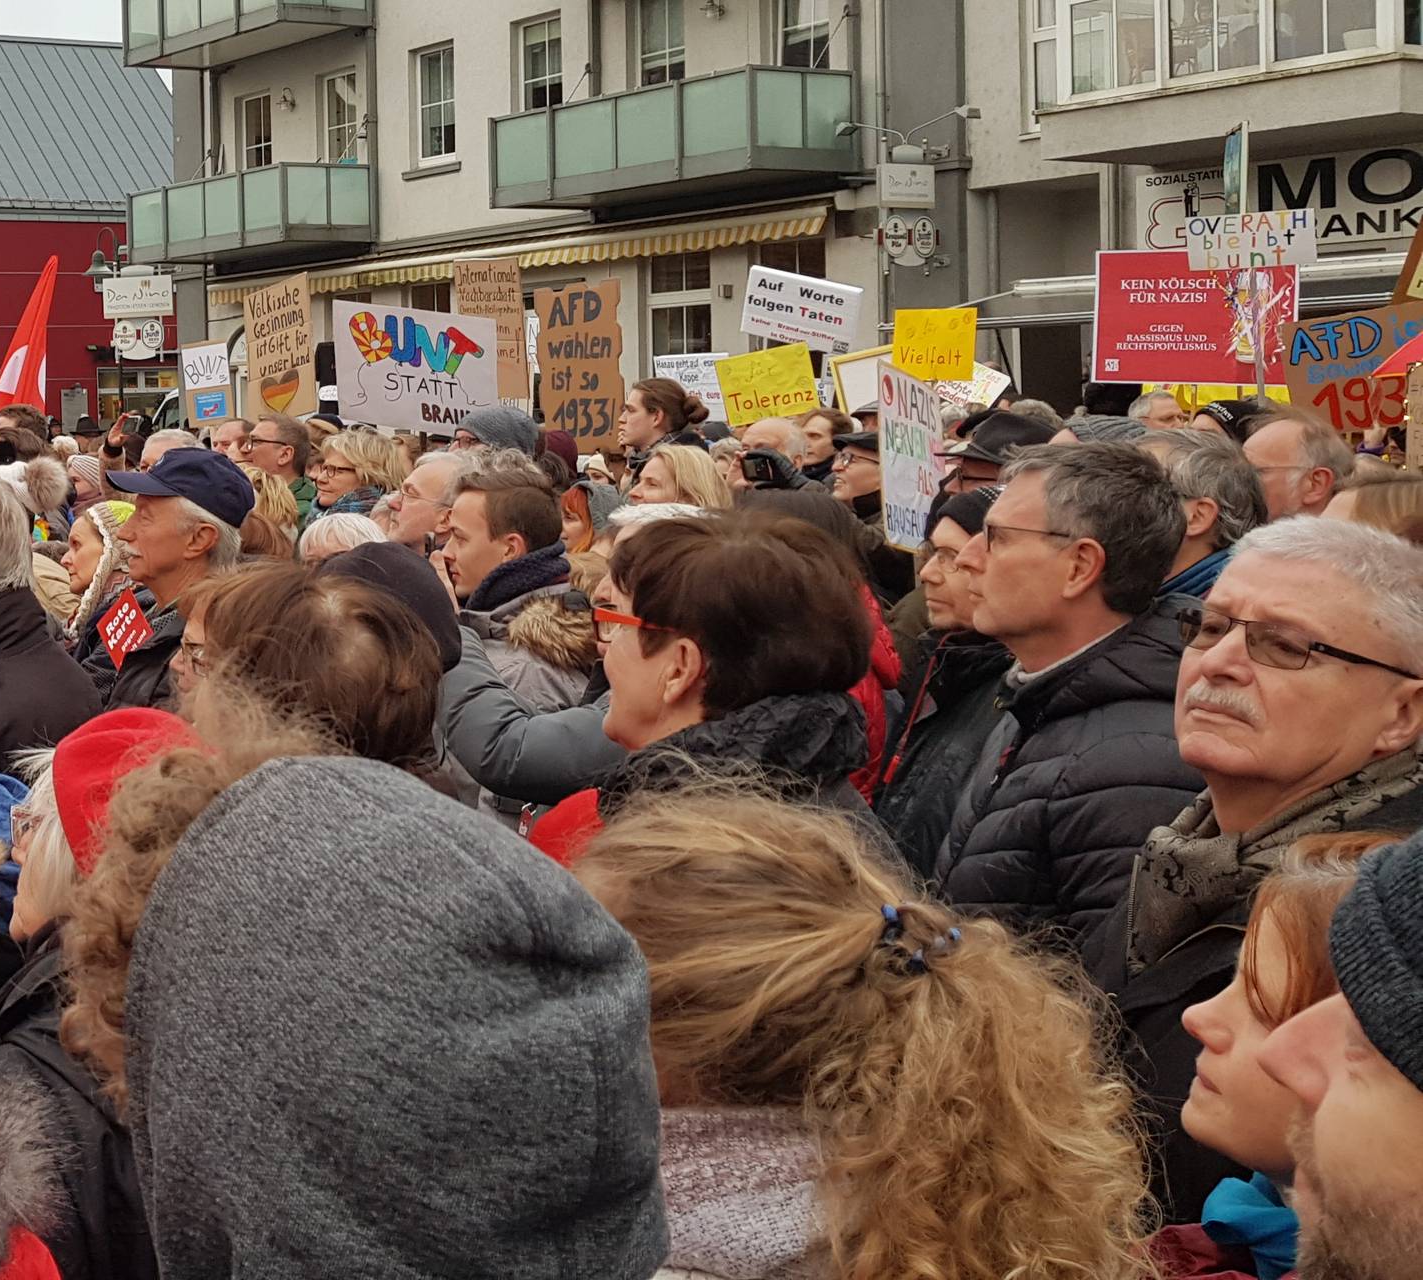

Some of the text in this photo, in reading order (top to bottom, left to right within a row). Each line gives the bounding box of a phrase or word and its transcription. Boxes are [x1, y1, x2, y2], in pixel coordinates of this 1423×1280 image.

[1145, 169, 1224, 187] SOZIALSTATI
[1188, 210, 1307, 236] OVERATH
[1315, 206, 1423, 238] ANK
[1203, 229, 1295, 249] bleibt
[1206, 245, 1286, 269] bunt
[456, 265, 517, 286] Internationale
[1121, 276, 1217, 290] KEIN KÖLSCH
[248, 285, 300, 320] Völkische
[757, 278, 845, 306] Auf Worte
[1129, 291, 1207, 303] FÜR NAZIS!
[253, 308, 305, 339] Gesinnung
[547, 291, 602, 329] AFD
[747, 294, 843, 326] folgen Taten
[295, 329, 308, 351] für
[1126, 334, 1207, 342] RASSISMUS UND
[1149, 324, 1184, 332] GEGEN
[1289, 316, 1382, 366] AFD
[349, 311, 484, 376] BUNT
[547, 332, 612, 360] wählen
[900, 346, 962, 368] Vielfalt
[1116, 342, 1217, 351] RECHTSPOPULISMUS
[184, 355, 227, 385] BUNT
[259, 346, 310, 377] unser Land
[384, 373, 457, 398] STATT
[551, 366, 599, 392] ist so
[421, 402, 471, 424] BRAU
[728, 389, 814, 412] Toleranz
[896, 377, 937, 432] NAZIS
[552, 398, 616, 437] 1933!
[885, 417, 927, 461] NERVEN
[917, 466, 935, 497] ALS
[105, 602, 130, 636] Rote
[107, 608, 137, 650] Karte
